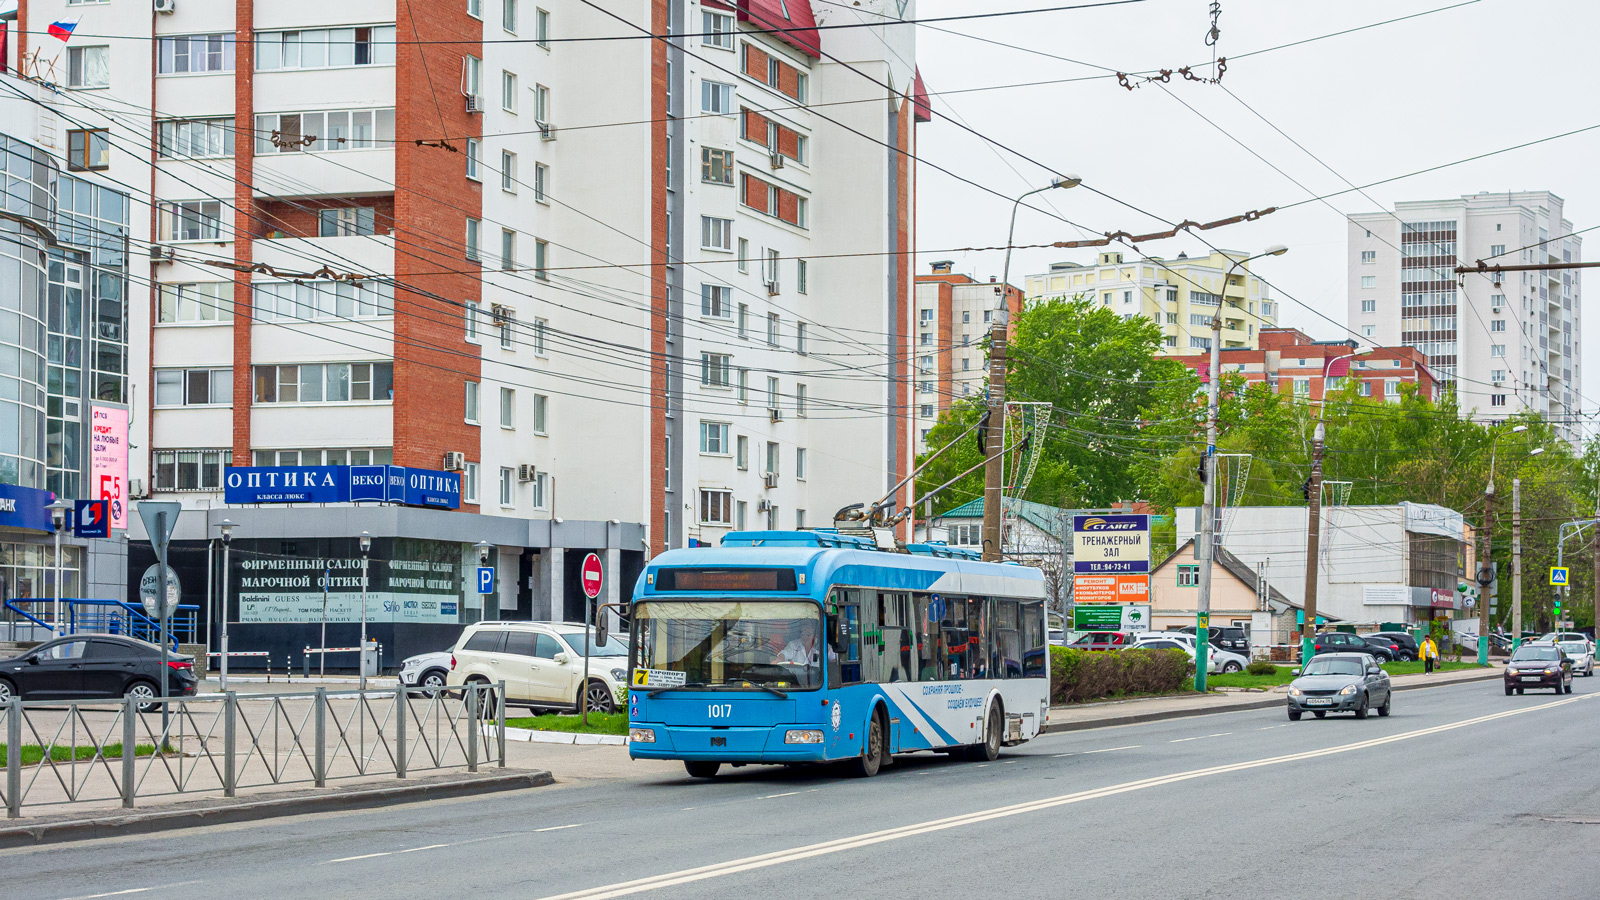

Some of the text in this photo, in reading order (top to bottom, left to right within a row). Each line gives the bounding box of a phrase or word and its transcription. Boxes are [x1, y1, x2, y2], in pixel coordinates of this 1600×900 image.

[94, 425, 112, 433] КРЕДИТ
[101, 436, 119, 444] ЛЮБЫЕ
[228, 472, 335, 488] ОПТИКА
[352, 475, 383, 485] ВЕКО
[390, 476, 404, 486] ВЕКО
[410, 474, 459, 494] ОПТИКА
[1082, 534, 1140, 546] ТРЕНАЖЕРНЫЙ
[1104, 548, 1120, 557] ЗАЛ
[242, 558, 324, 570] ФИРМЕННЫЙ
[389, 560, 452, 572] ФИРМЕННЫЙ САЛОН
[242, 576, 310, 587] МАРОЧНОЙ
[389, 577, 452, 590] МАРОЧНОЙ ОПТИКИ
[482, 570, 492, 590] P
[636, 670, 648, 684] 7
[708, 704, 732, 718] 1017
